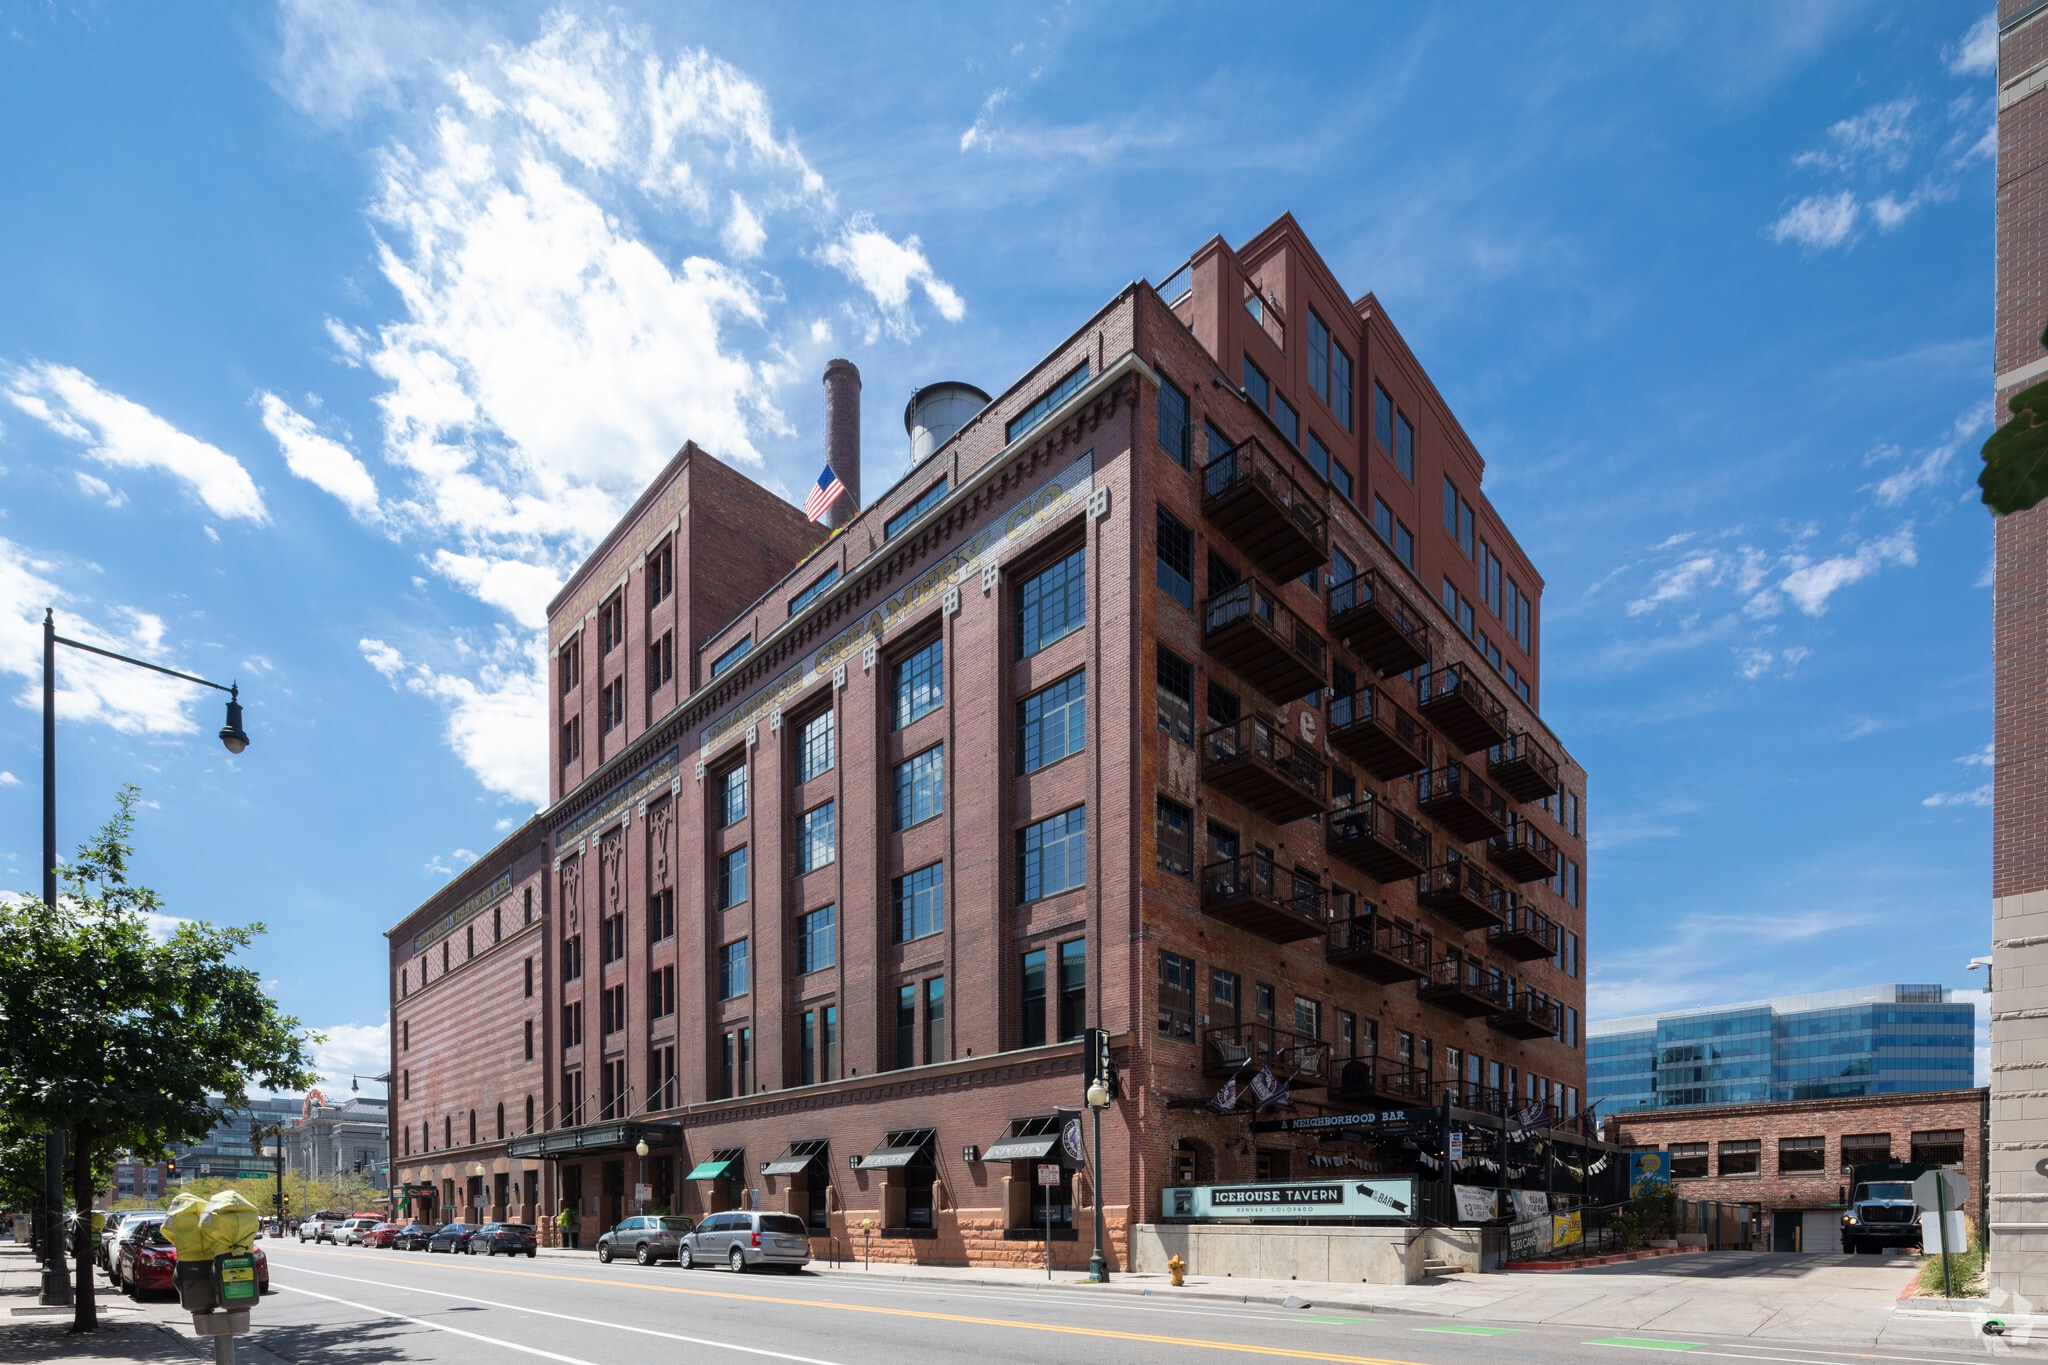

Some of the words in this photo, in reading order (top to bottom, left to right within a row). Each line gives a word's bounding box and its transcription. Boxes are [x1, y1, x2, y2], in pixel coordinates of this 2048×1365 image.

[552, 577, 597, 640] MEADOW
[600, 541, 632, 589] GOLD
[636, 481, 684, 549] BUTTER
[707, 668, 804, 751] BEATRICE
[815, 531, 991, 676] CREAMERY
[1004, 481, 1072, 541] CO.
[1281, 1121, 1288, 1129] A
[1292, 1113, 1376, 1128] NEIGHBORHOOD
[1381, 1111, 1405, 1122] BAR
[993, 1145, 1043, 1156] SPORTS
[1215, 1191, 1281, 1203] ICEHOUSE
[1286, 1189, 1338, 1202] TAVERN
[1377, 1192, 1394, 1207] BAR
[1523, 1235, 1537, 1248] CANS
